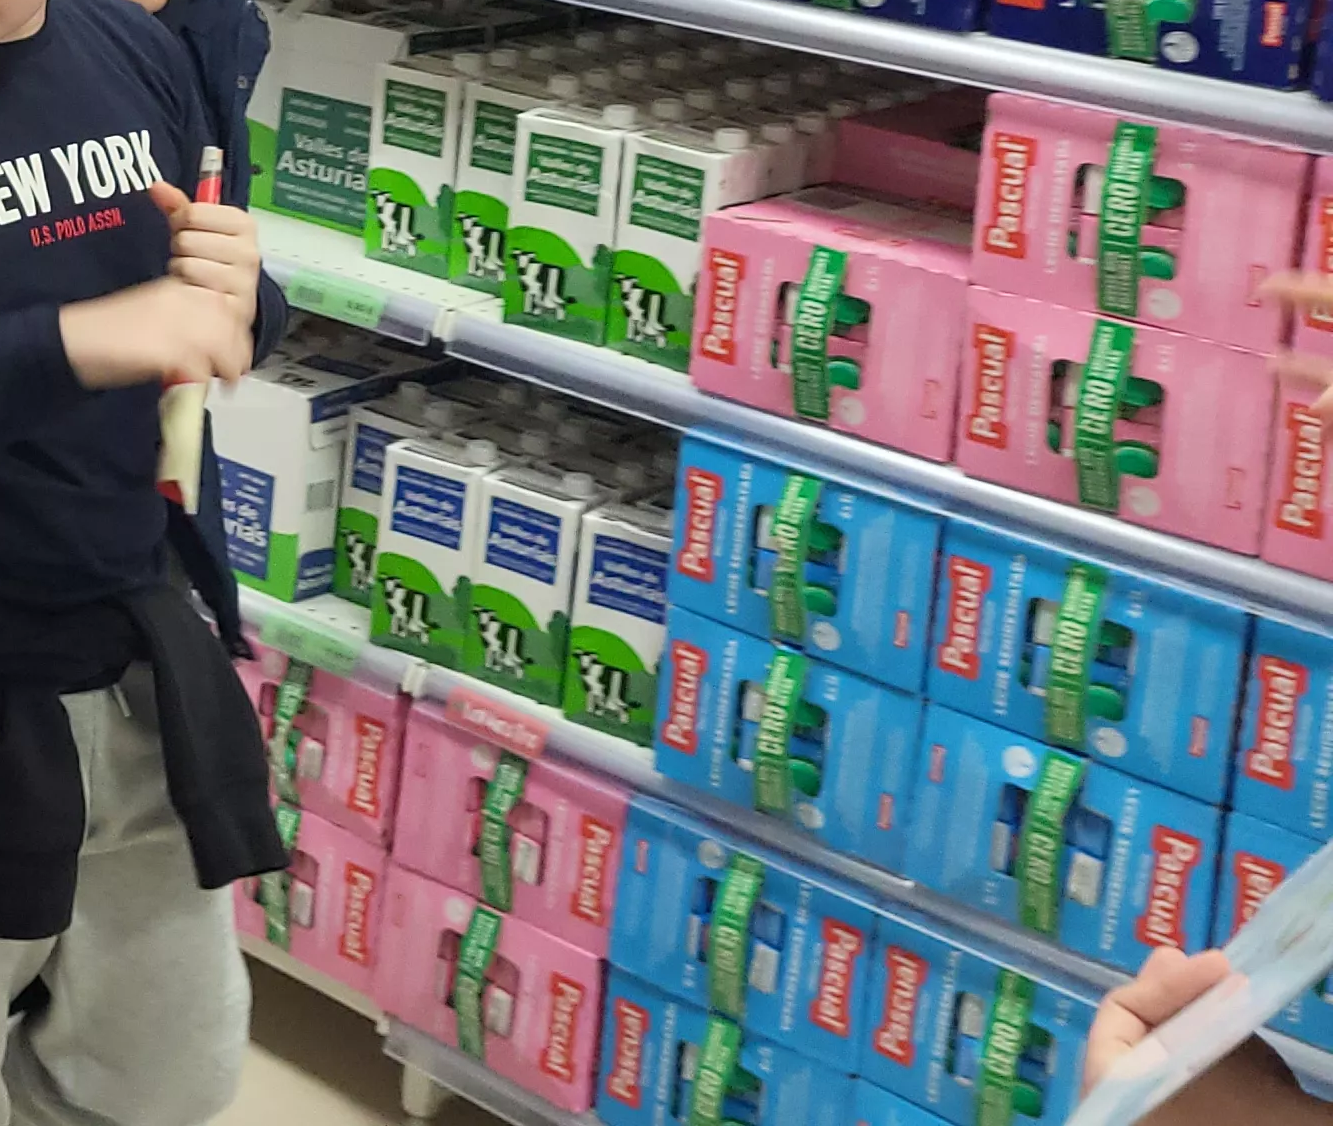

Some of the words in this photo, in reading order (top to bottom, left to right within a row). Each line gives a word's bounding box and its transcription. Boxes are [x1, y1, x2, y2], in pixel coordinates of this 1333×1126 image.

[51, 129, 164, 206] YORK
[276, 150, 368, 192] Asturia
[293, 133, 344, 158] Valles
[987, 139, 1028, 250] Pascual
[30, 225, 55, 247] U.S.
[57, 215, 86, 240] POLO
[88, 208, 126, 232] ASSN.
[1103, 182, 1139, 237] CERO
[704, 256, 740, 355] Pascual
[794, 300, 825, 351] CERO
[971, 329, 1006, 438] Pascual
[1077, 379, 1115, 435] CERO
[1281, 412, 1323, 527] Pascual
[682, 473, 718, 575] Pascual
[943, 562, 985, 671] Pascual
[665, 647, 705, 747] Pascual
[1250, 665, 1300, 780] Pascual
[353, 721, 386, 813] Pascual
[342, 868, 373, 962] Pascual
[578, 822, 613, 921] Pascual
[1142, 834, 1197, 948] Pascual
[819, 926, 860, 1032] Pascual
[877, 955, 920, 1058] Pascual
[545, 982, 582, 1076] Pascual
[613, 1005, 645, 1101] Pascual
